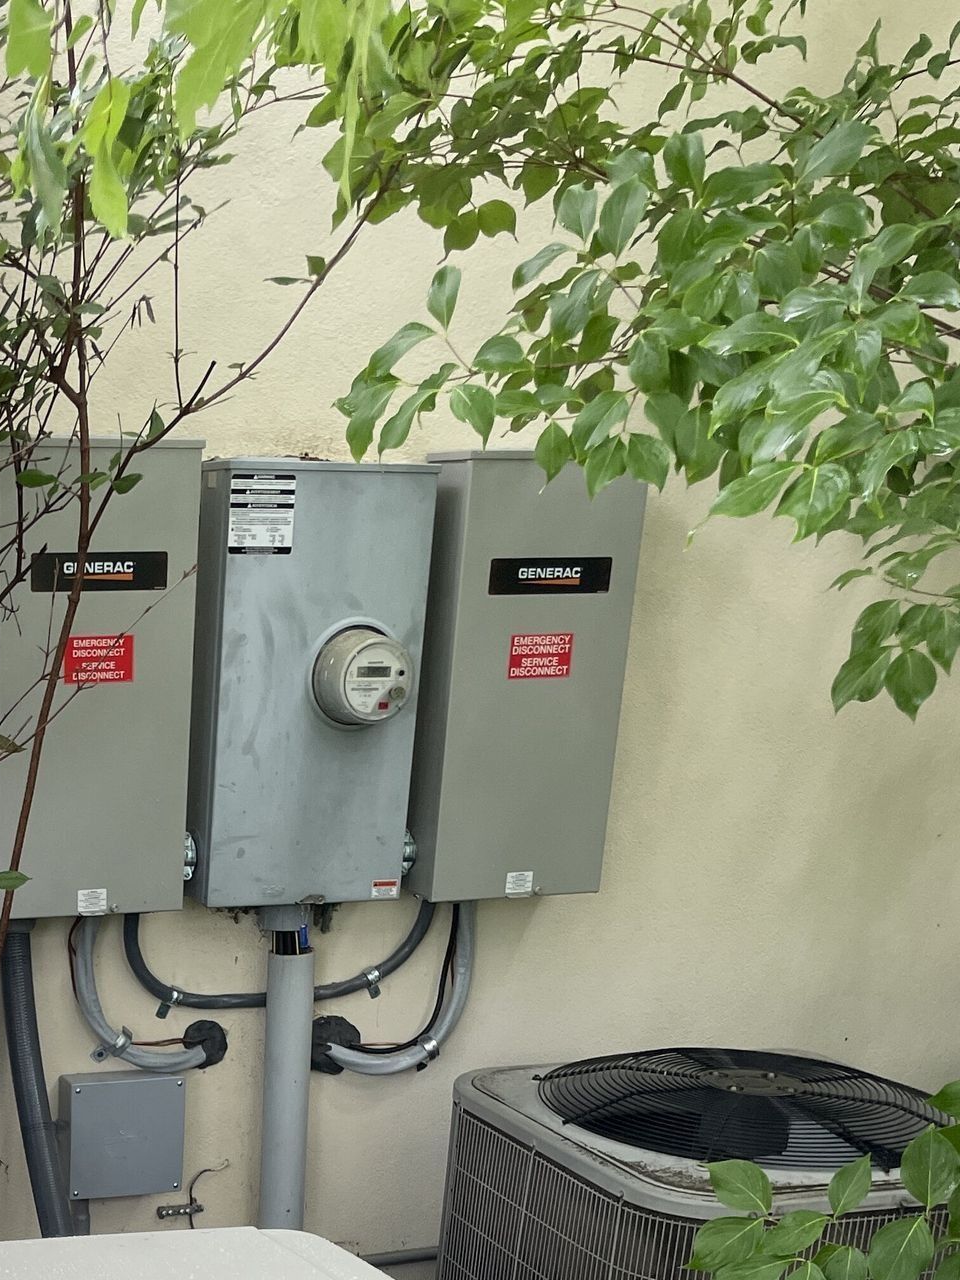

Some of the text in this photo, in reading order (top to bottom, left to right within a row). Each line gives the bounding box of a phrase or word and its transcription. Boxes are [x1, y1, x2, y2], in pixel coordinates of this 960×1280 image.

[518, 567, 581, 579] GENERAC
[73, 638, 125, 648] EMERGENCY
[513, 635, 571, 646] EMERGENCY
[72, 648, 125, 658] DISCONNECT
[512, 645, 571, 655] DISCONNECT
[521, 657, 559, 667] SERVICE
[510, 666, 568, 677] DISCONNECT
